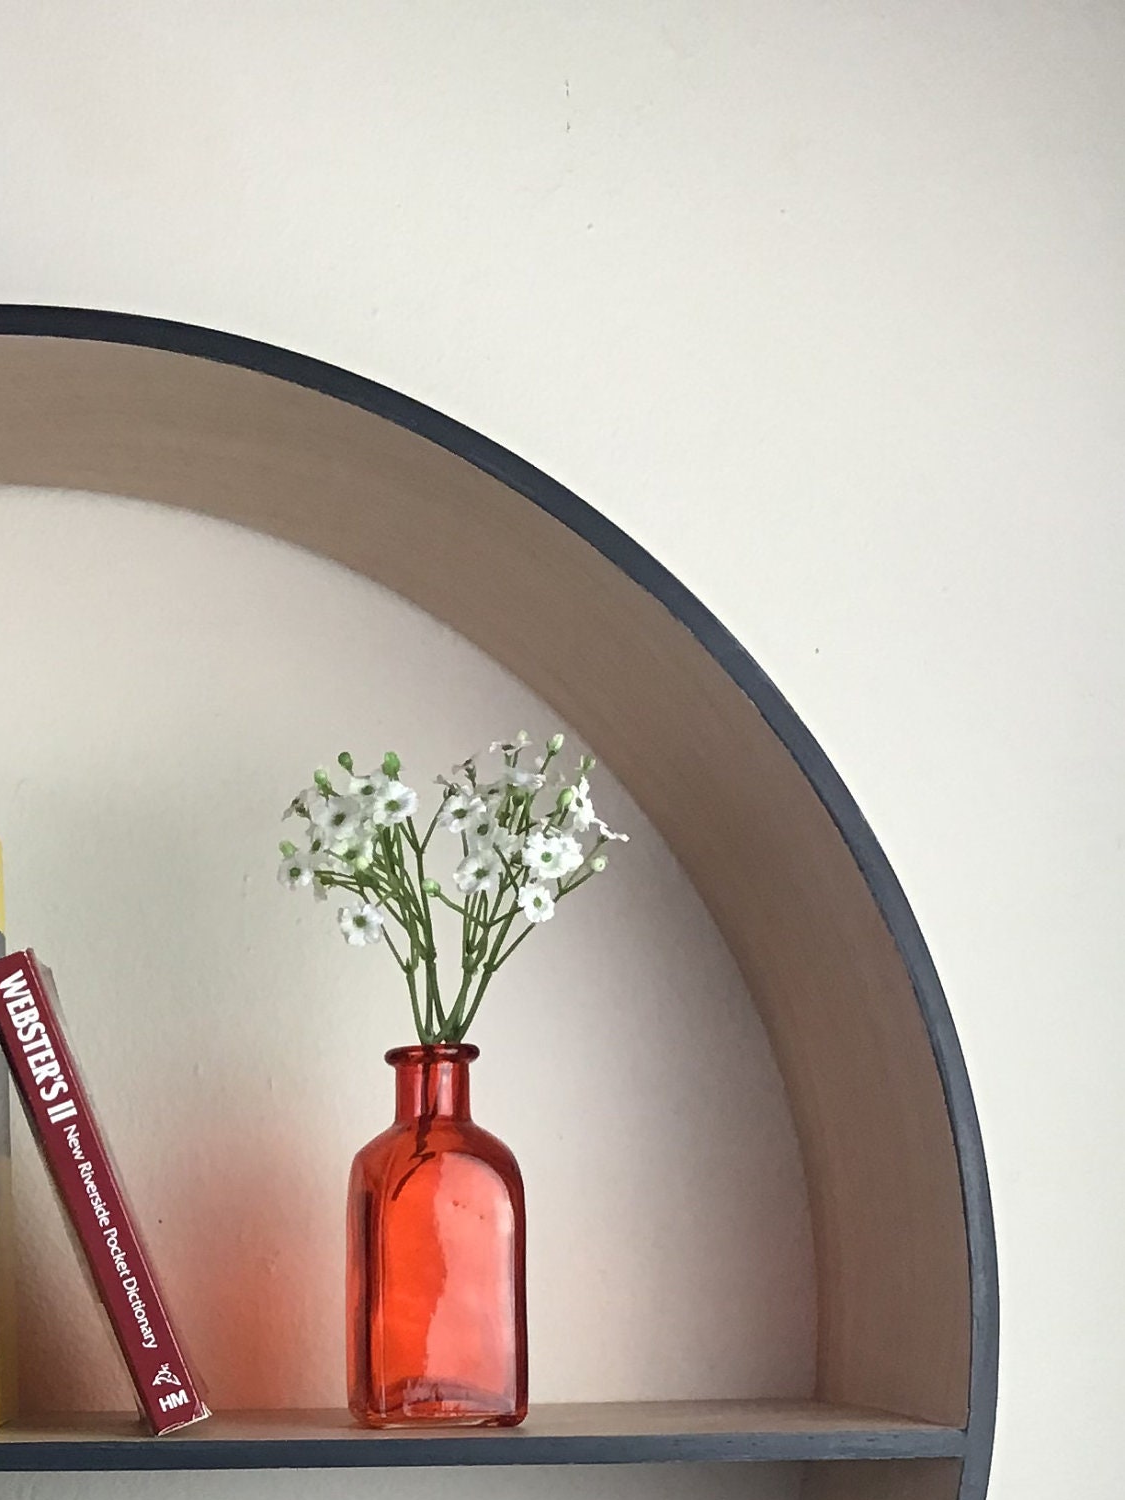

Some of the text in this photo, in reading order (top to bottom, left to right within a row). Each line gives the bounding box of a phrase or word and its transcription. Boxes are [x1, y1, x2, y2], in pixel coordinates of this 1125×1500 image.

[46, 1098, 78, 1125] II
[63, 1124, 85, 1161] New
[77, 1161, 110, 1228] Riverside
[103, 1226, 131, 1278] Pocket
[122, 1275, 158, 1350] Dictionary
[158, 1388, 191, 1413] HM
